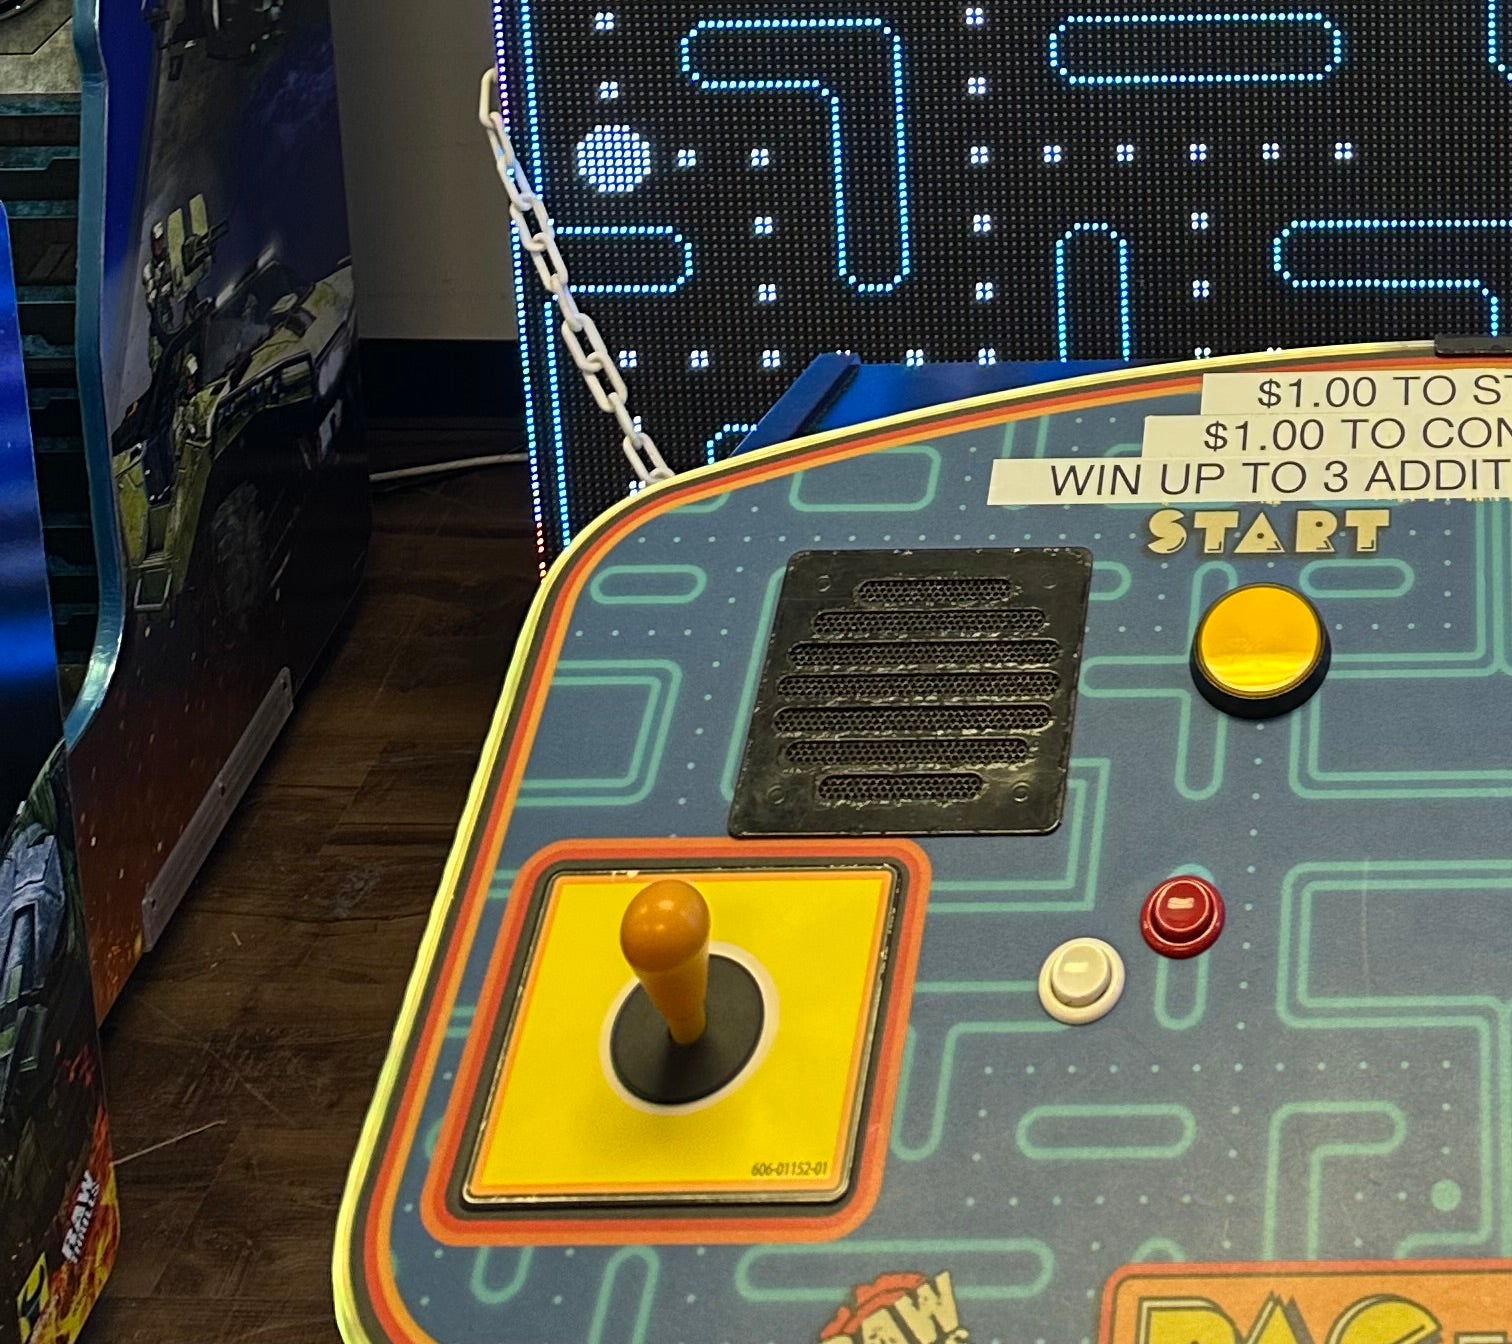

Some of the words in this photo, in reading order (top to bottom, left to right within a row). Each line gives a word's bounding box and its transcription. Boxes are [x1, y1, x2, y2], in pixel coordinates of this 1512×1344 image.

[1257, 375, 1377, 409] $1.00
[1393, 375, 1457, 407] TO
[1204, 418, 1325, 453] $1.00
[1341, 418, 1405, 450] TO
[1050, 463, 1142, 496] WIN
[1160, 463, 1226, 495] UP
[1242, 461, 1307, 494] TO
[1323, 460, 1350, 493] 3
[1146, 508, 1392, 555] START
